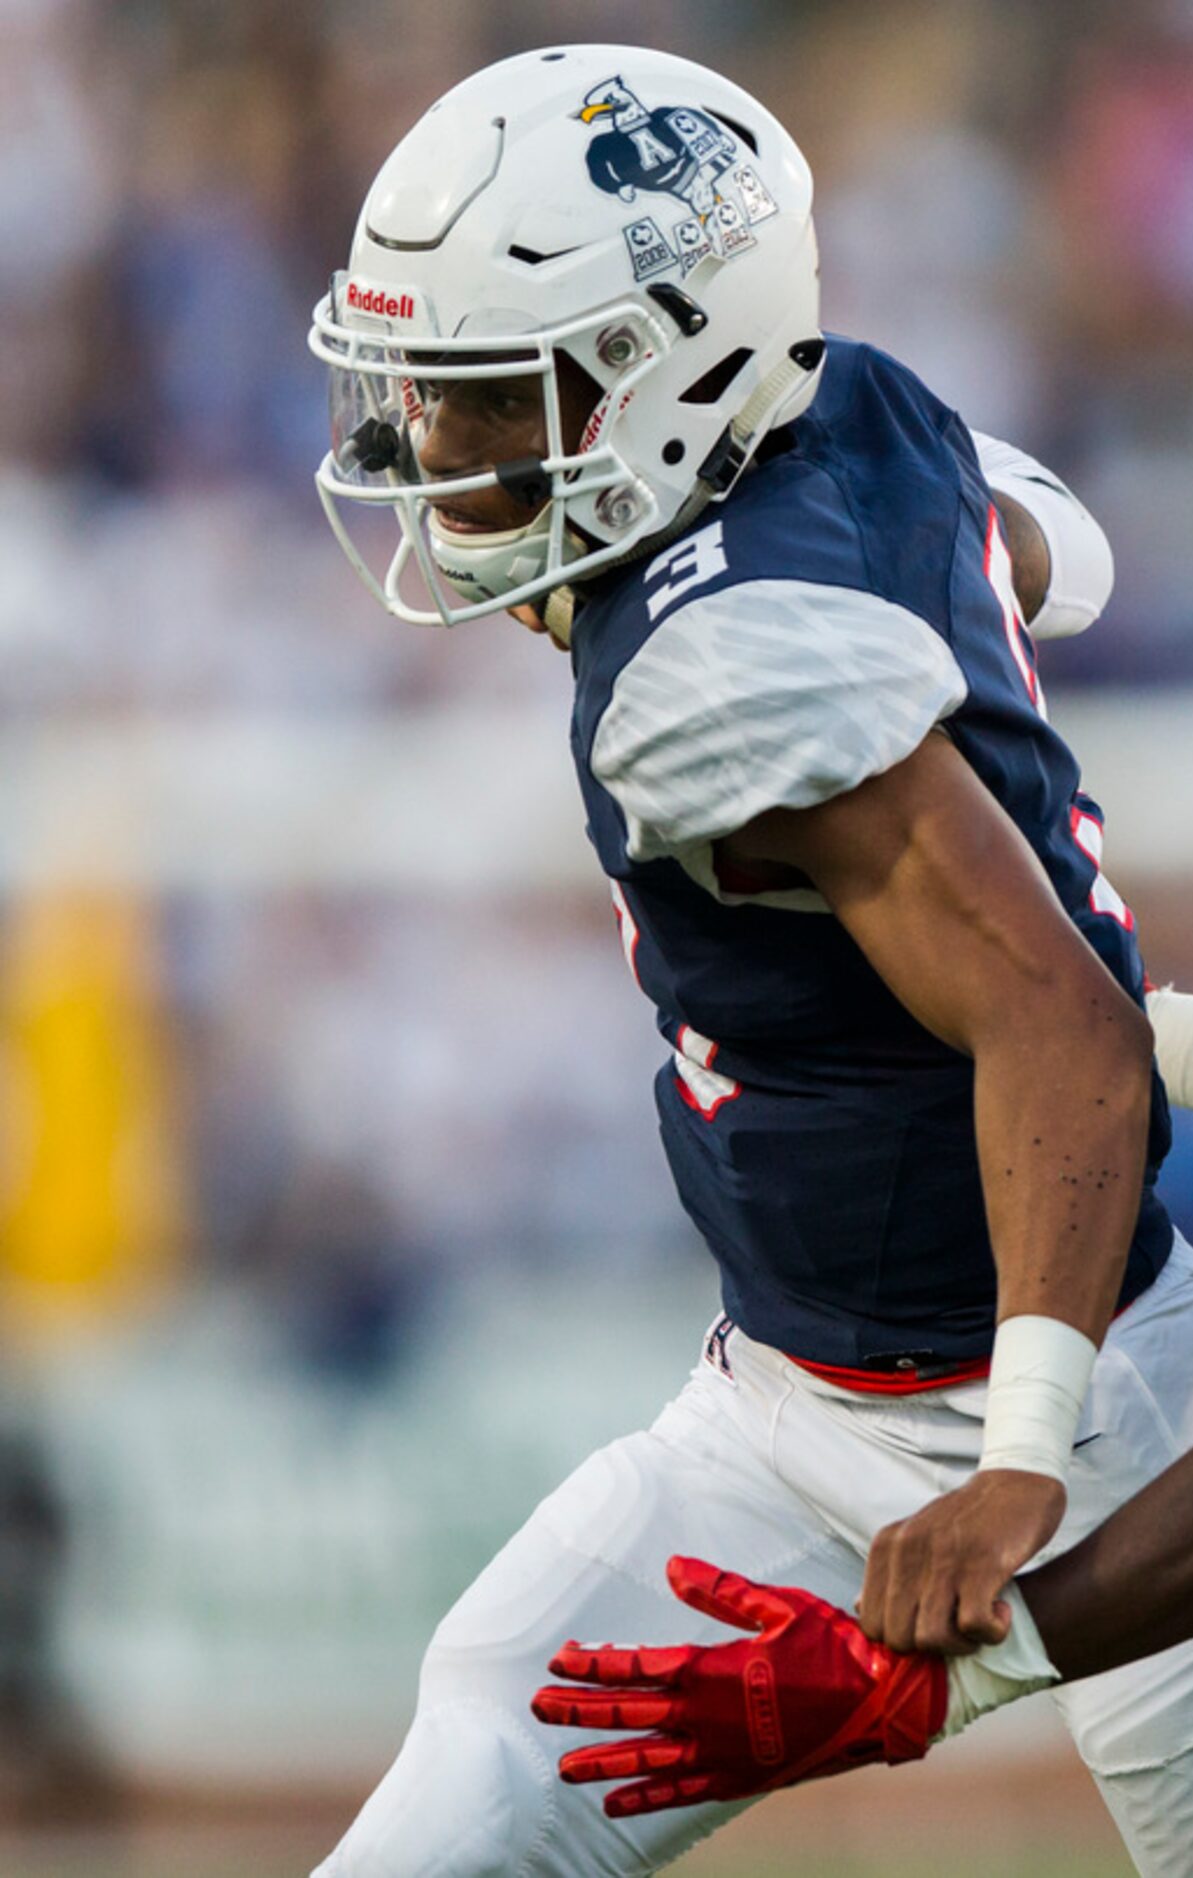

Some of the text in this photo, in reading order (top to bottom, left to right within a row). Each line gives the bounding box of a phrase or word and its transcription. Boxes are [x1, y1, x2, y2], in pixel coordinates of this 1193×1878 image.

[628, 127, 677, 171] A
[347, 283, 414, 319] Riddell
[643, 520, 729, 622] 3
